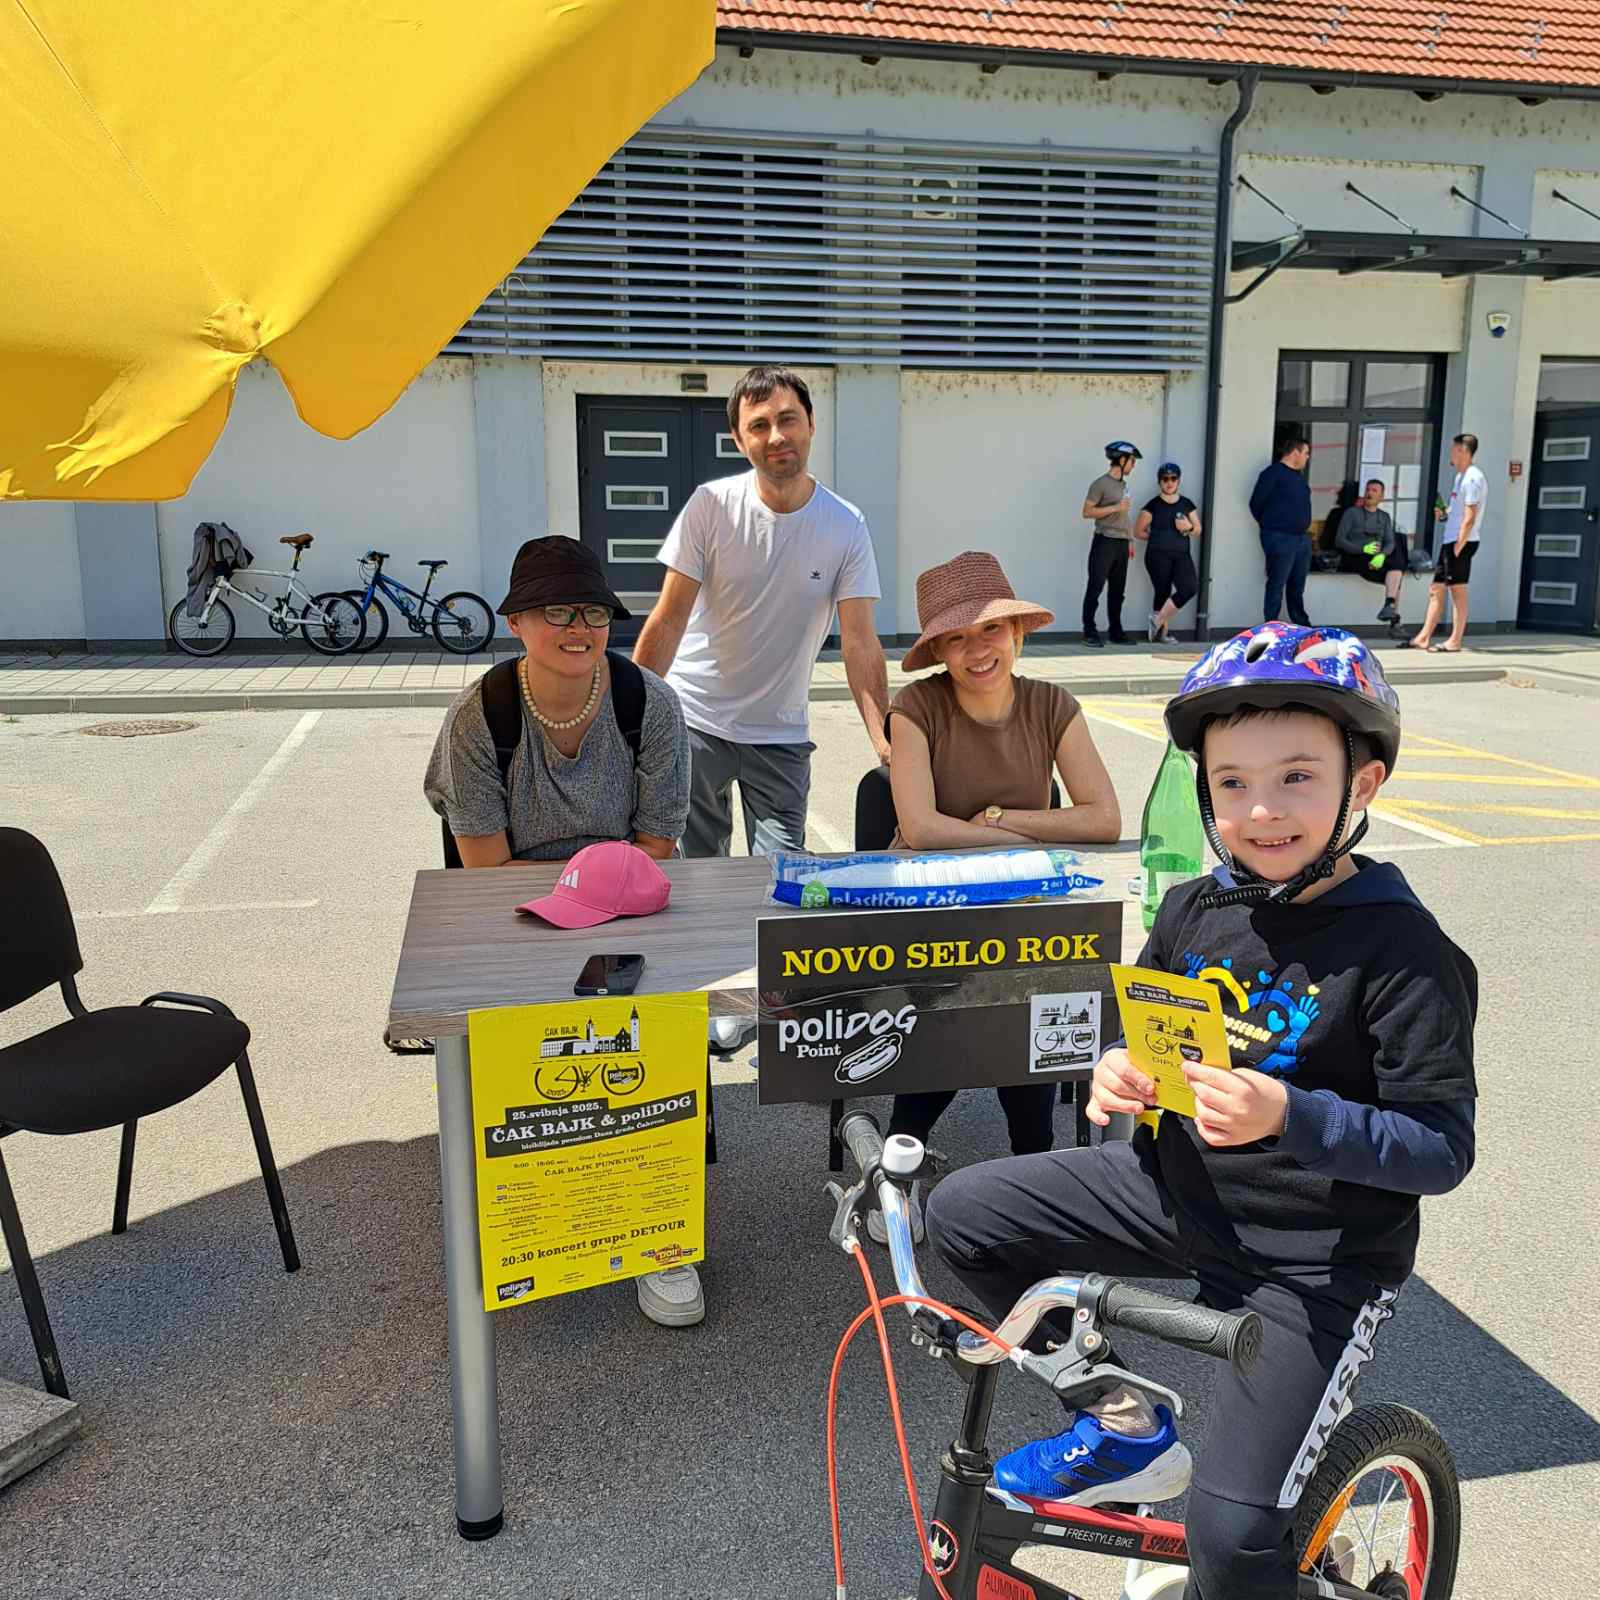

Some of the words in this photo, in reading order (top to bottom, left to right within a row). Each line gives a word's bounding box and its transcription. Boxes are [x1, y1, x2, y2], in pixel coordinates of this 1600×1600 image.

[781, 945, 895, 977] NOVO
[906, 939, 1006, 969] SELO
[1017, 934, 1100, 963] ROK
[778, 1004, 918, 1051] poliDOG
[796, 1043, 842, 1059] Point
[492, 1124, 537, 1144] ČAK
[540, 1117, 596, 1136] BAJK
[600, 1114, 617, 1127] &
[621, 1096, 691, 1125] poliDOG
[512, 1106, 569, 1121] 25.svibnja
[572, 1101, 603, 1113] 2025.
[501, 1251, 534, 1267] 20:30
[537, 1241, 587, 1260] koncert
[590, 1233, 626, 1248] grupe
[630, 1219, 686, 1239] DETOUR
[1066, 1527, 1116, 1546] FREESTYLE
[1115, 1536, 1136, 1548] BIKE
